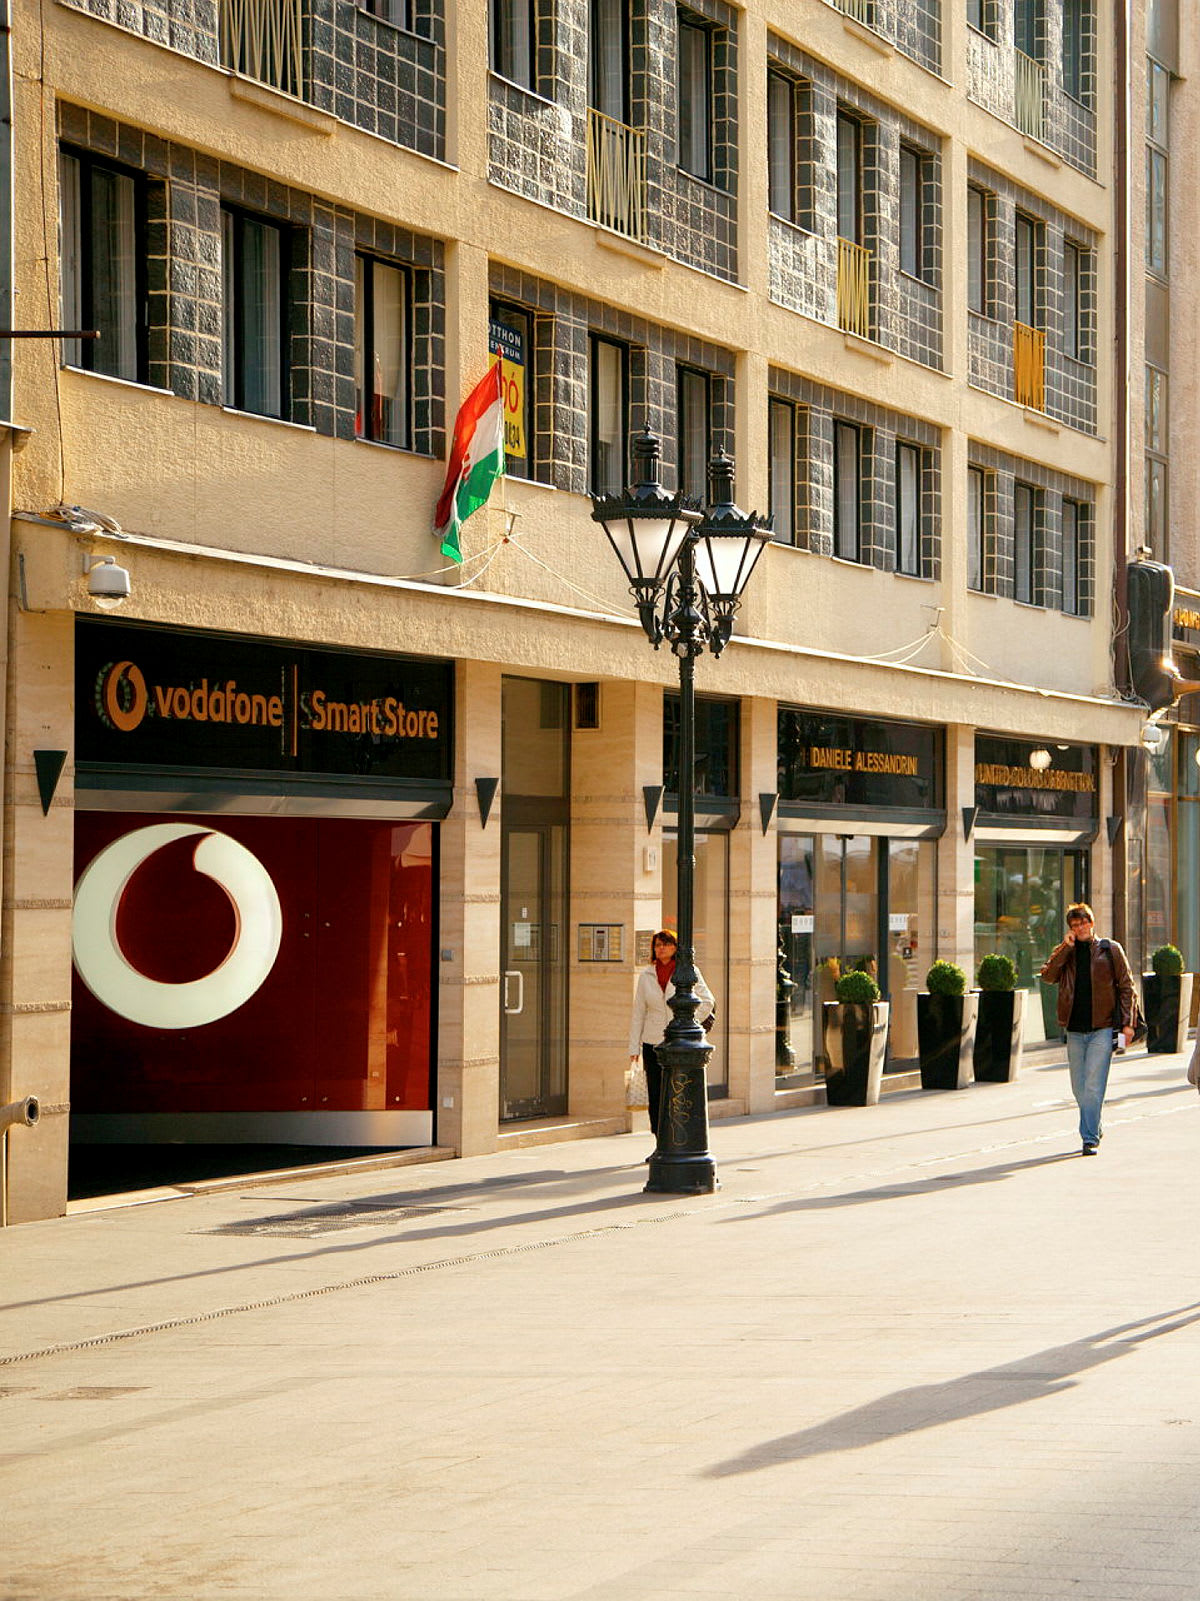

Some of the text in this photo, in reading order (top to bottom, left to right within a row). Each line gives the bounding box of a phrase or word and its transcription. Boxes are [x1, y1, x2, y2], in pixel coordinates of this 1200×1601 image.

[156, 678, 439, 739] vodafone Smart Store
[811, 747, 918, 776] DANIELE ALESSANDRINI
